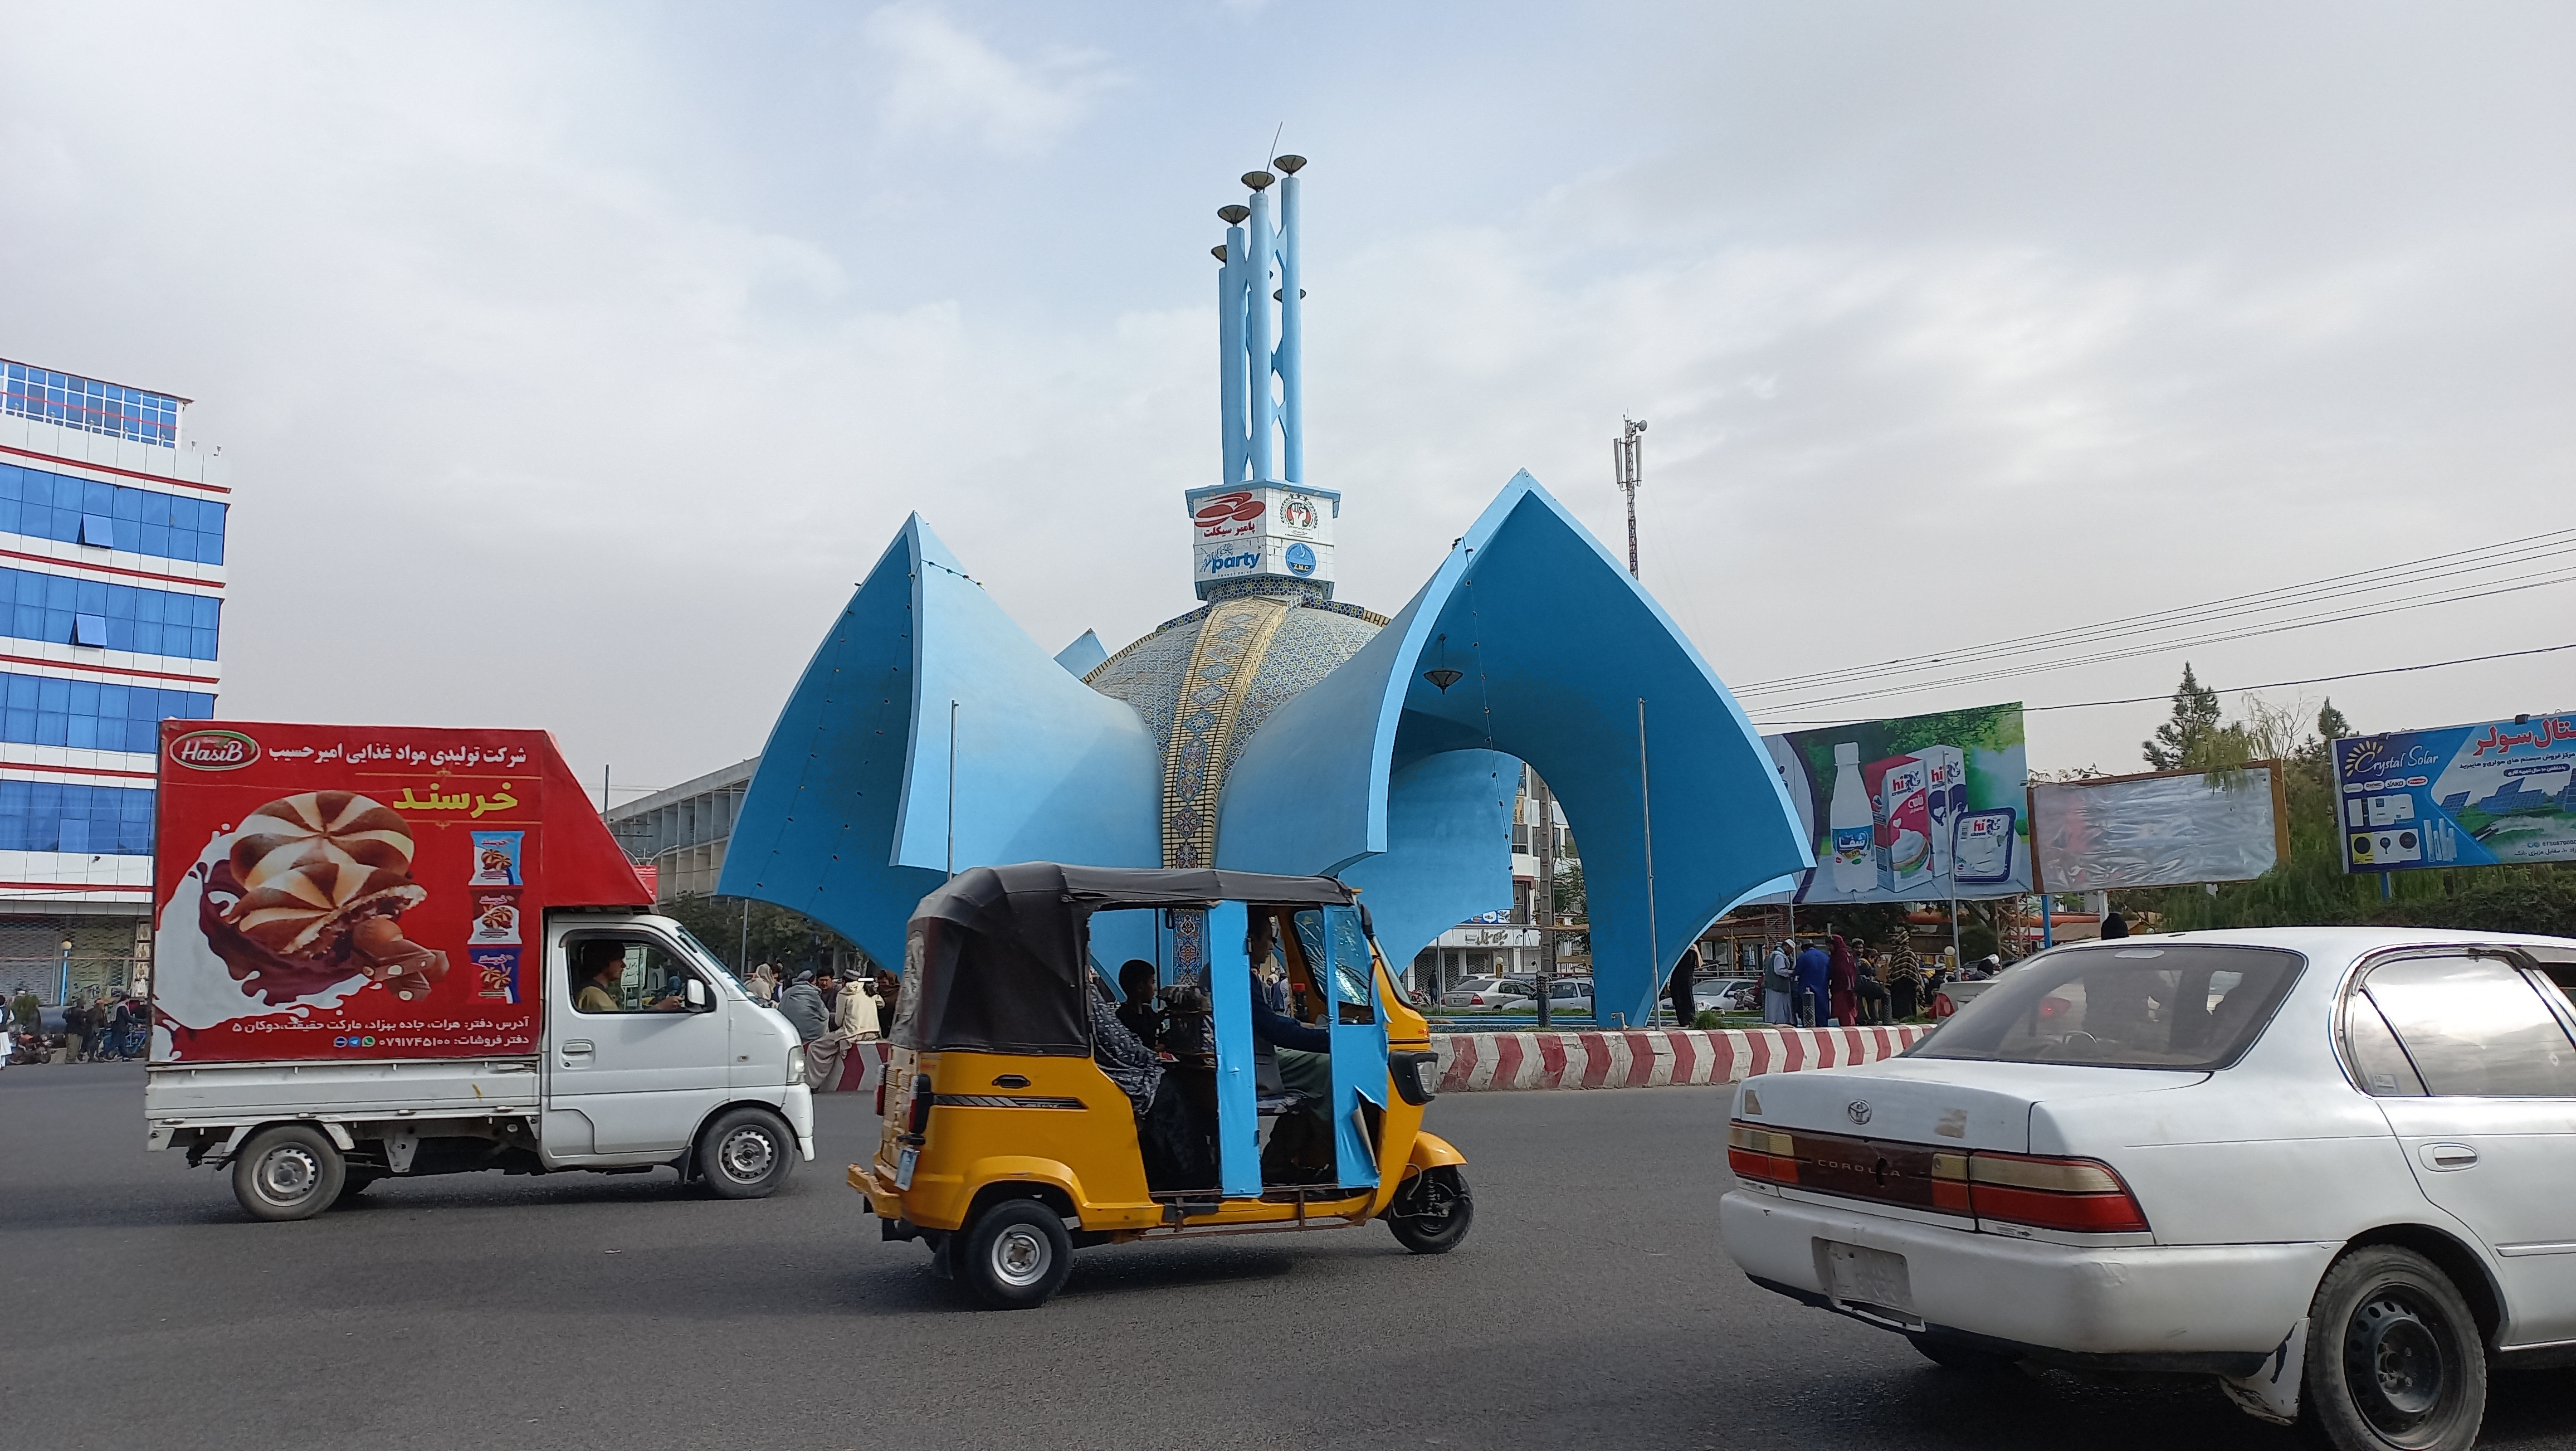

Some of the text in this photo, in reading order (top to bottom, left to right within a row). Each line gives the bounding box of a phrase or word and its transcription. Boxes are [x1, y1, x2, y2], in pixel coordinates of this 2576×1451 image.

[1204, 521, 1255, 537] پامیر سیکلت
[1212, 552, 1261, 573] party
[2473, 726, 2532, 756] سولر
[181, 739, 243, 762] HasiB
[345, 743, 392, 764] غذایی
[396, 744, 427, 766] مواد
[430, 746, 480, 767] تولیدی
[483, 747, 526, 767] شرکت
[2355, 746, 2438, 776] Crystal Solar
[1931, 766, 1943, 783] hi
[1892, 776, 1904, 791] hi
[393, 782, 519, 819] خرسند
[1974, 819, 1986, 831] hi
[232, 1022, 242, 1031] ۵
[326, 1020, 362, 1031] مارکت
[399, 1020, 425, 1031] جاده
[464, 1018, 493, 1030] دفتر:
[495, 1016, 530, 1030] آدرس
[504, 1035, 529, 1046] دفتر
